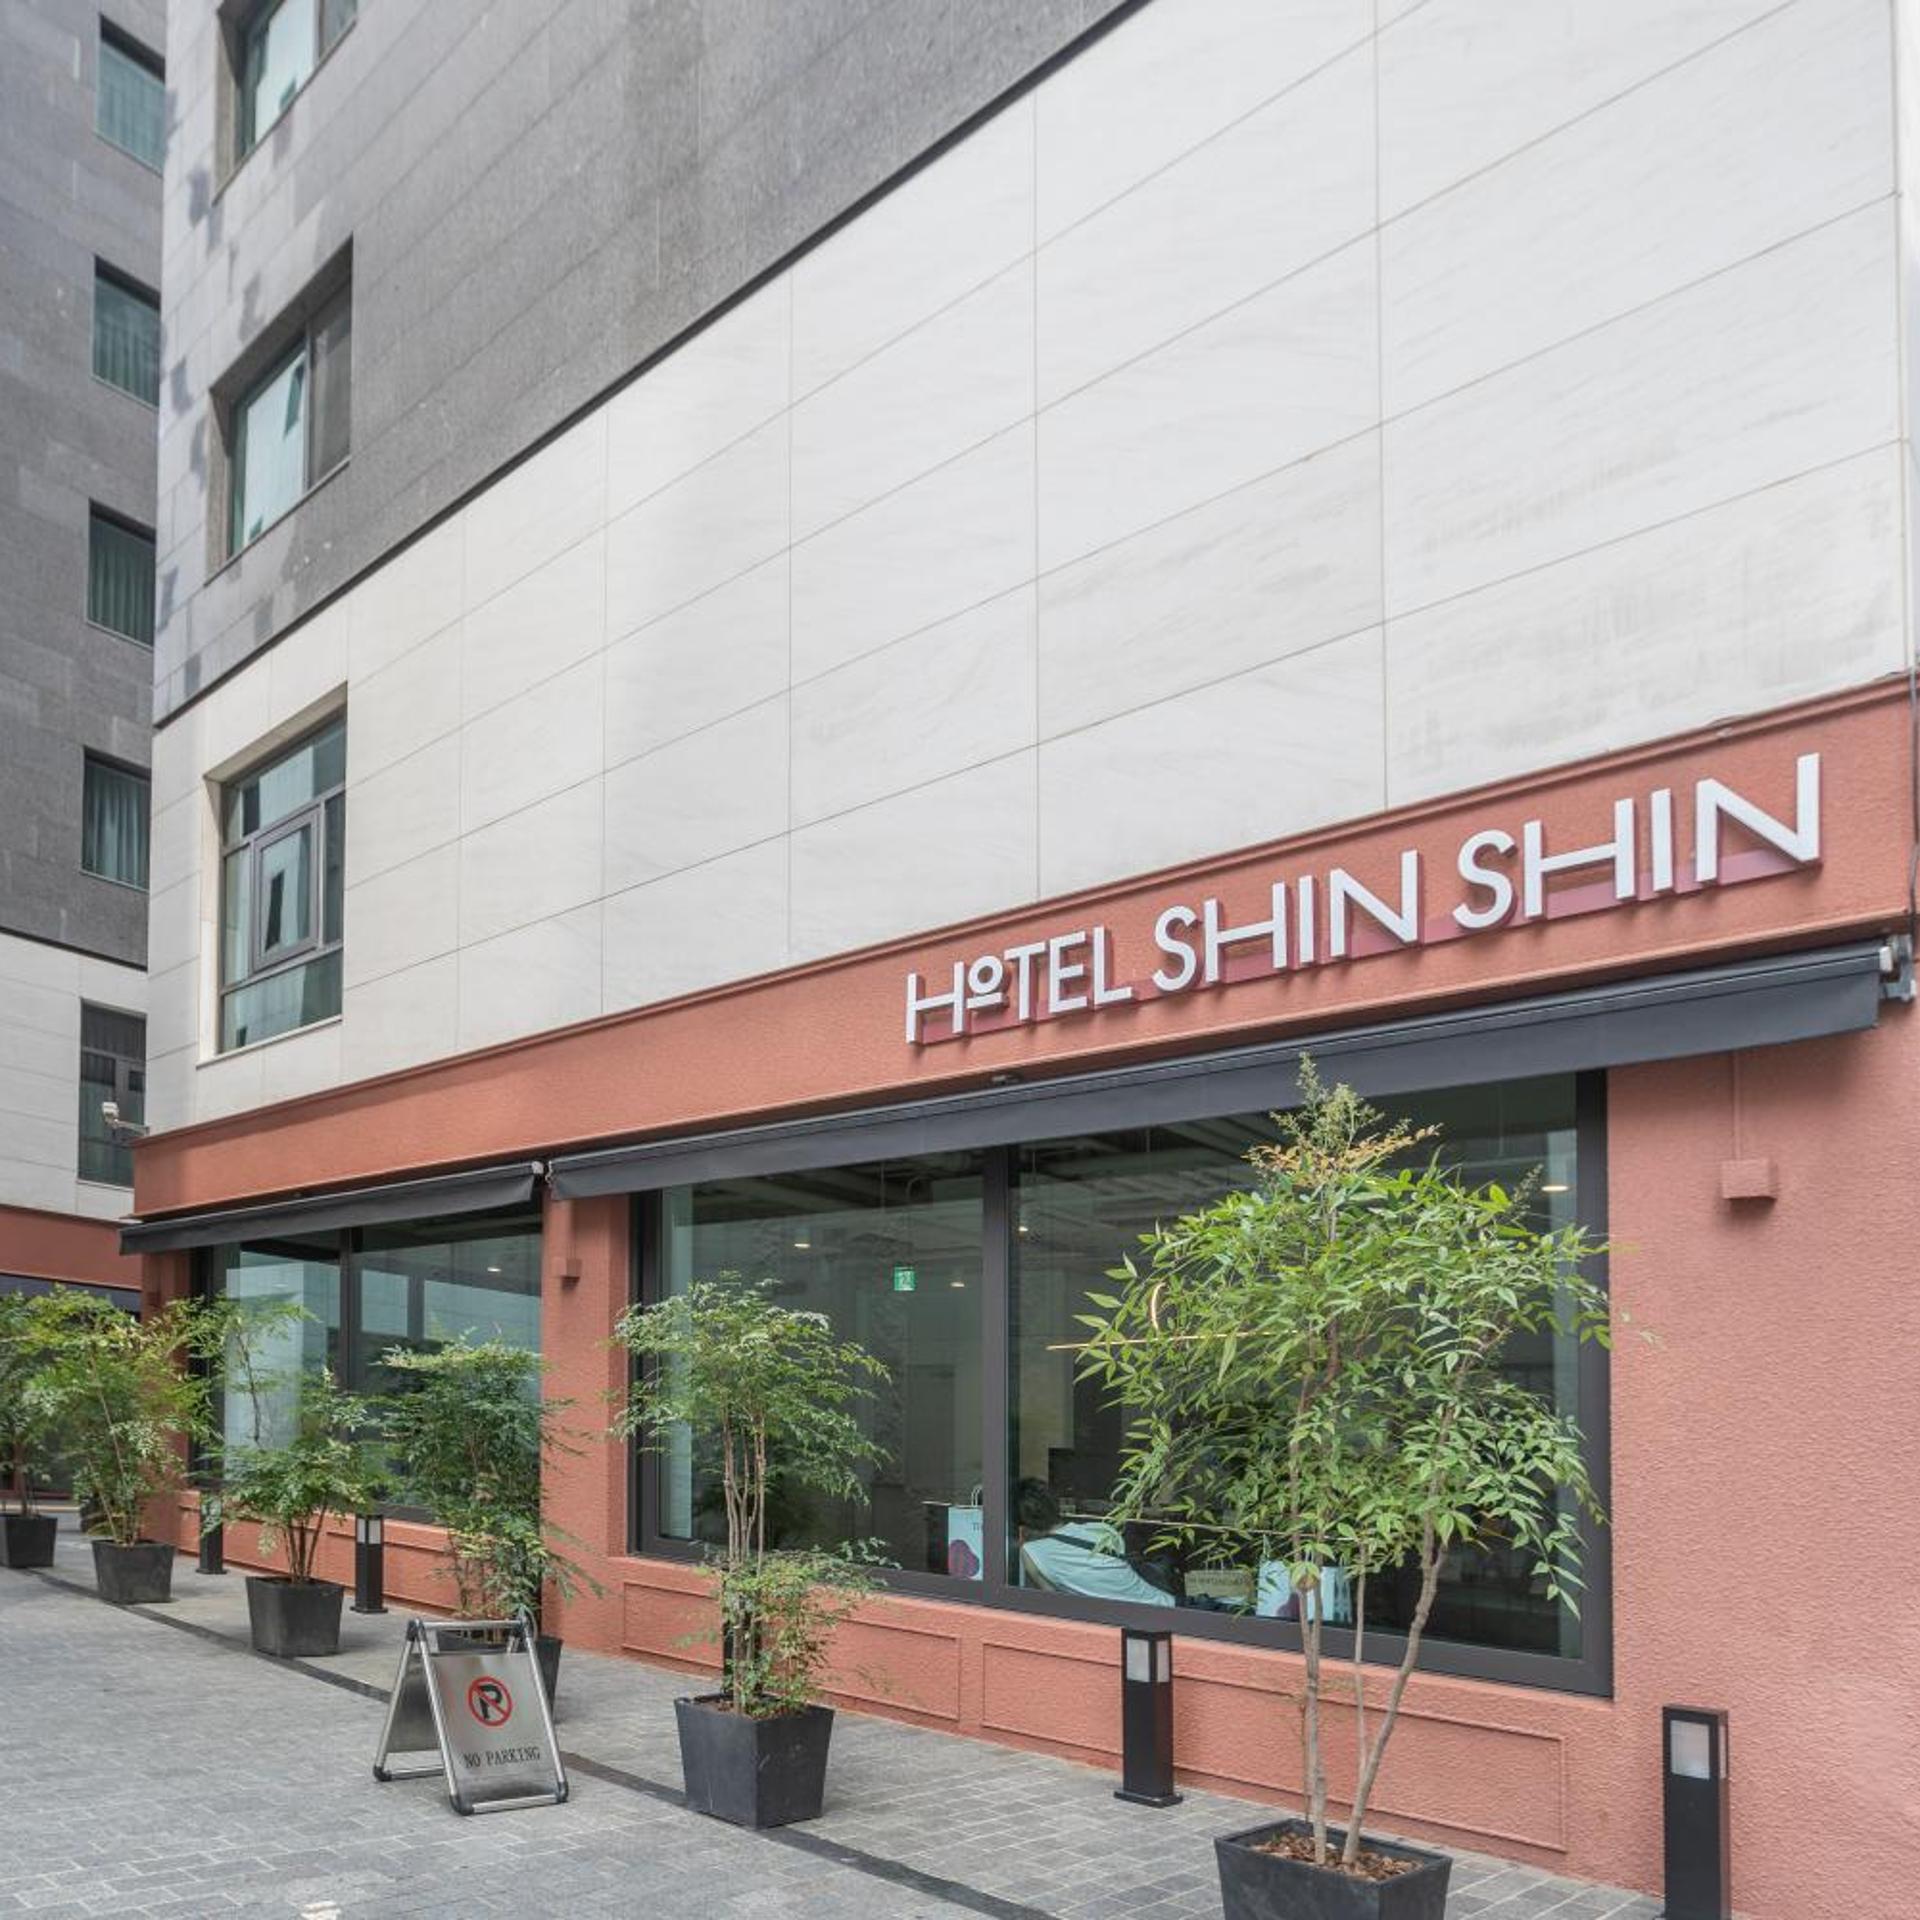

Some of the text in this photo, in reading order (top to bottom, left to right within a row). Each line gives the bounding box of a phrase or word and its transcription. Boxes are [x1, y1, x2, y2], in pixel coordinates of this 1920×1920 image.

[1153, 850, 1420, 992] SHIN
[1452, 752, 1822, 930] SHIN
[463, 1746, 541, 1768] NO PARKING
